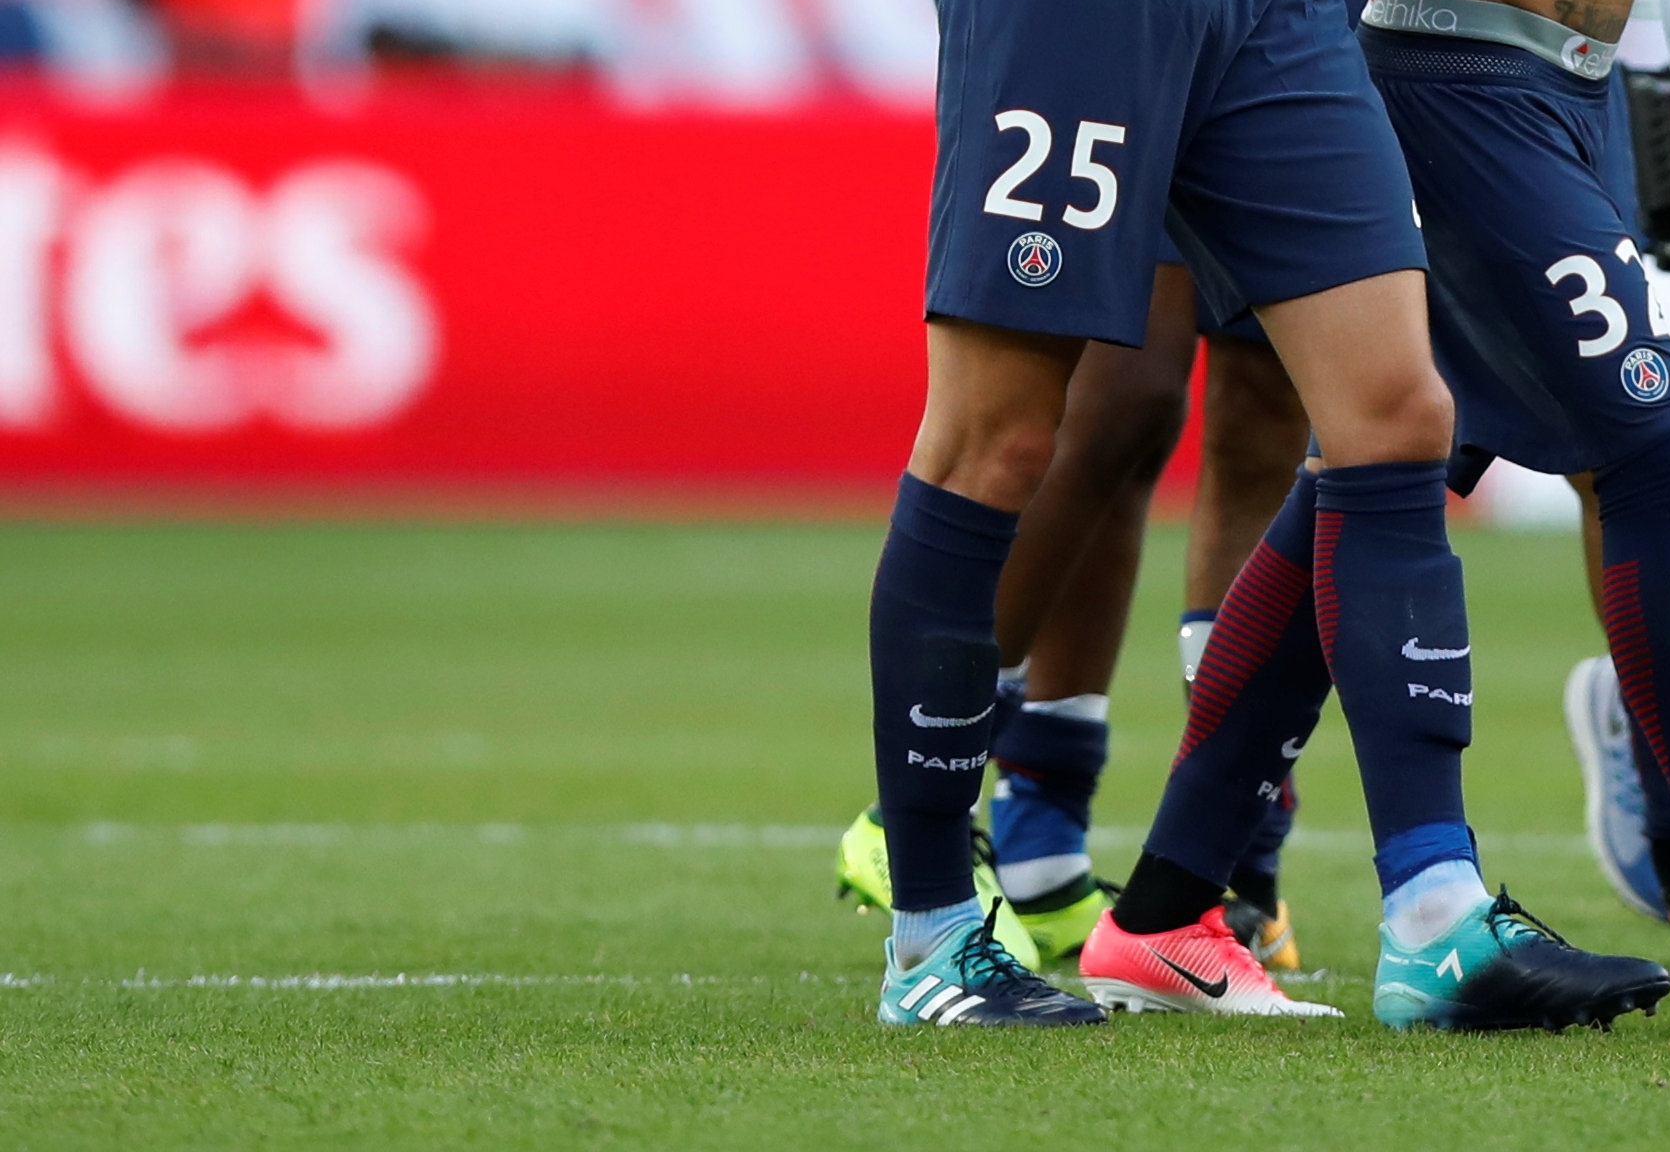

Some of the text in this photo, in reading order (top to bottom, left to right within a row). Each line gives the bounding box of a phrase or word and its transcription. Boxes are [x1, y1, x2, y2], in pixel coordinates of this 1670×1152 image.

[983, 109, 1126, 230] 25
[1019, 235, 1055, 250] PARIS
[1624, 351, 1654, 371] PARIS
[907, 749, 988, 771] PARIS
[1256, 779, 1282, 803] PA
